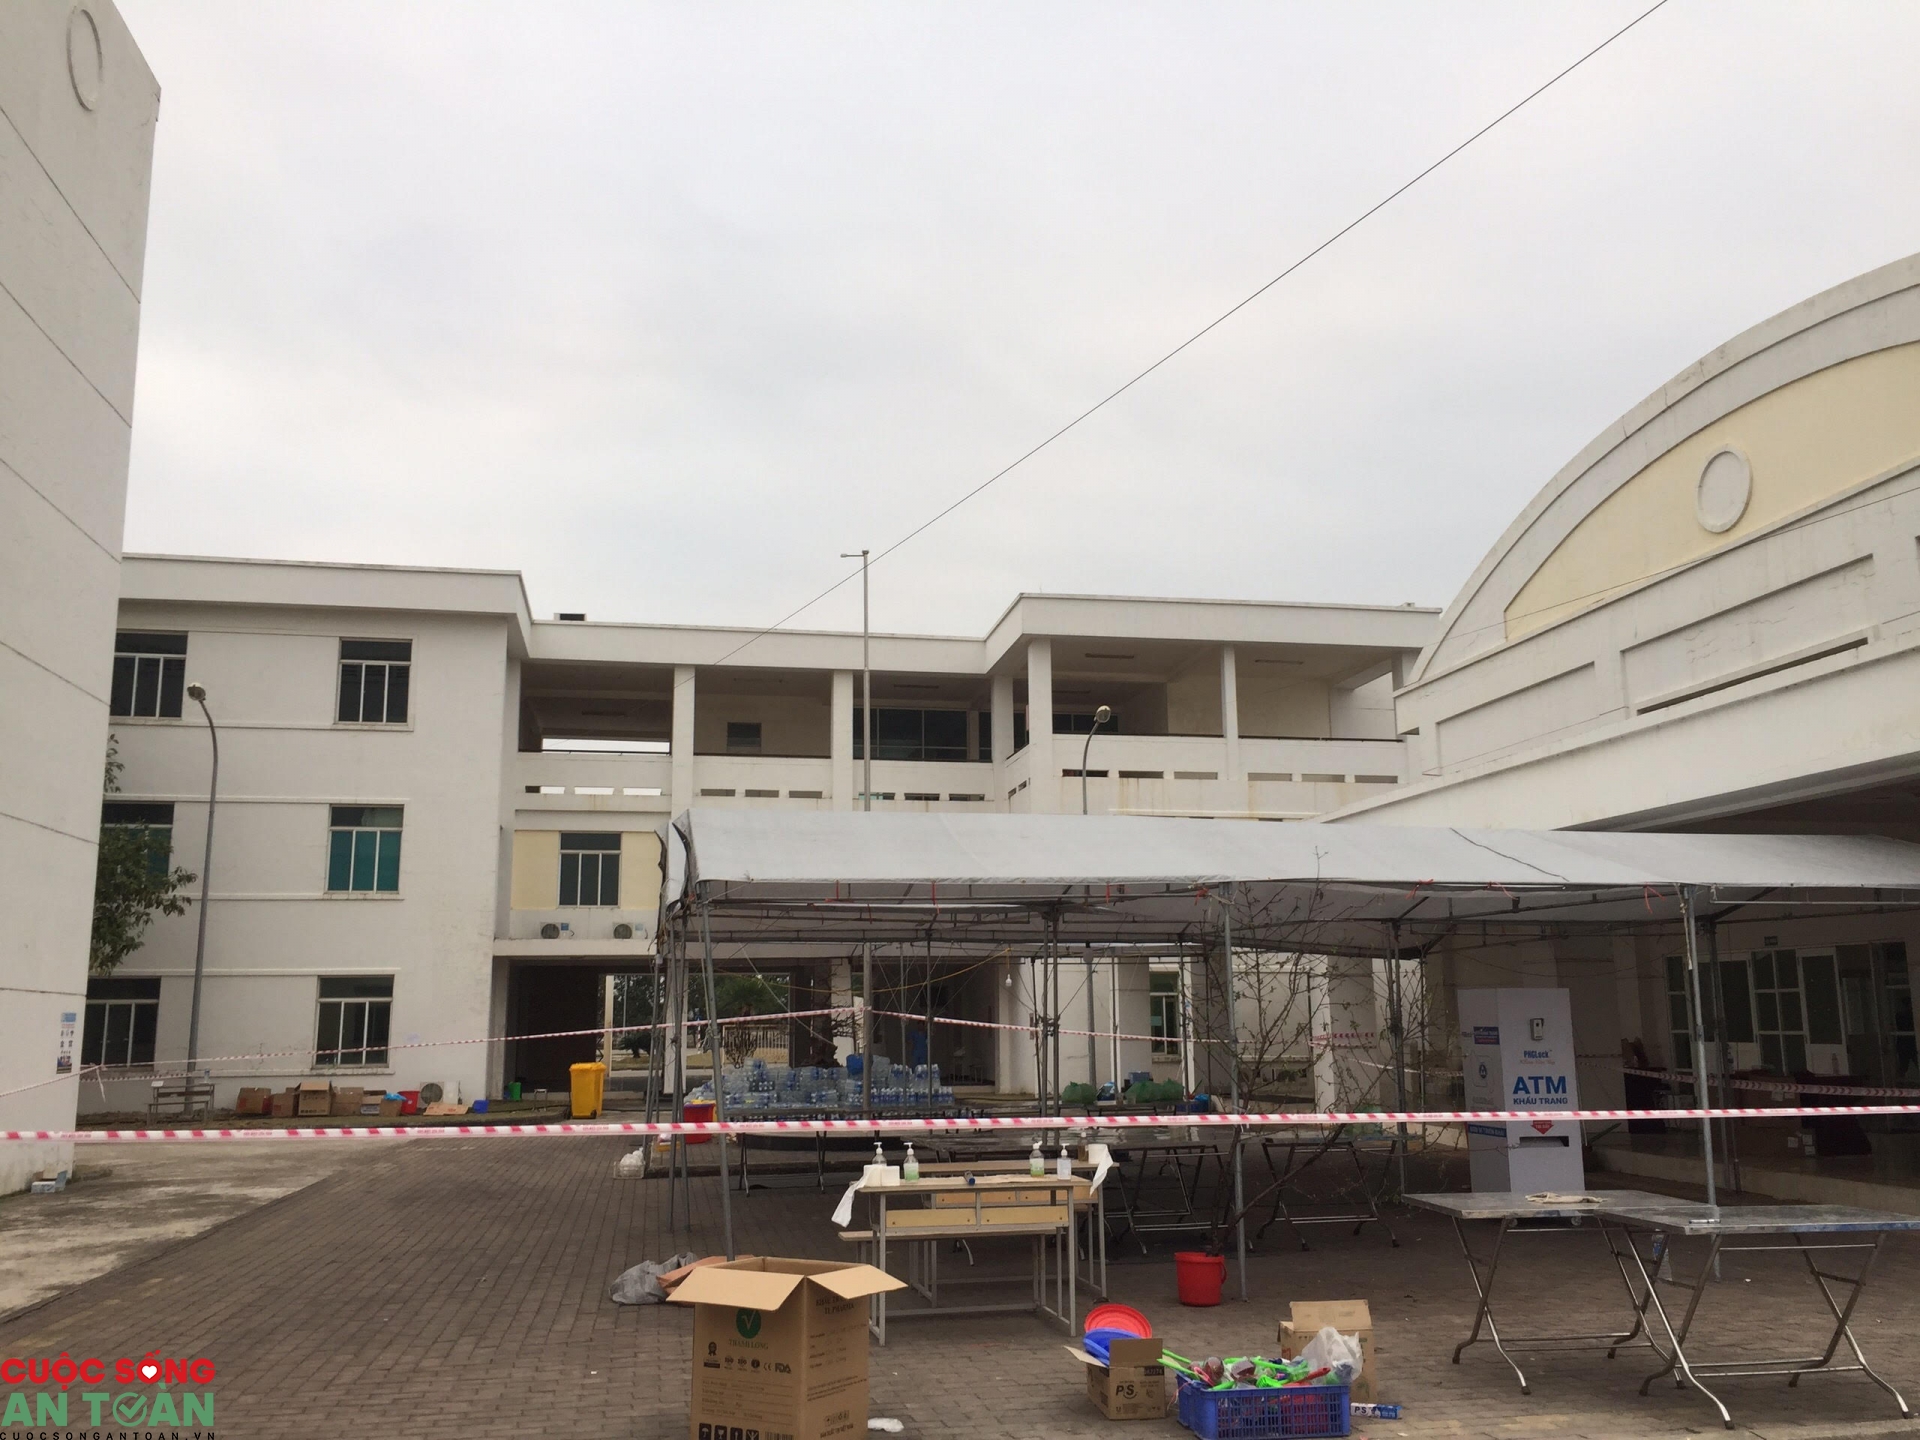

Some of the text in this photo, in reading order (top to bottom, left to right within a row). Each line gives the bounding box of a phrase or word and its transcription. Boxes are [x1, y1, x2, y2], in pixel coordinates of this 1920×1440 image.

[1513, 1076, 1567, 1094] ATM
[1539, 1097, 1568, 1105] TRANG
[752, 1341, 769, 1350] LONG
[775, 1362, 792, 1374] FDA
[1116, 1384, 1135, 1396] PS
[1354, 1406, 1367, 1414] PS
